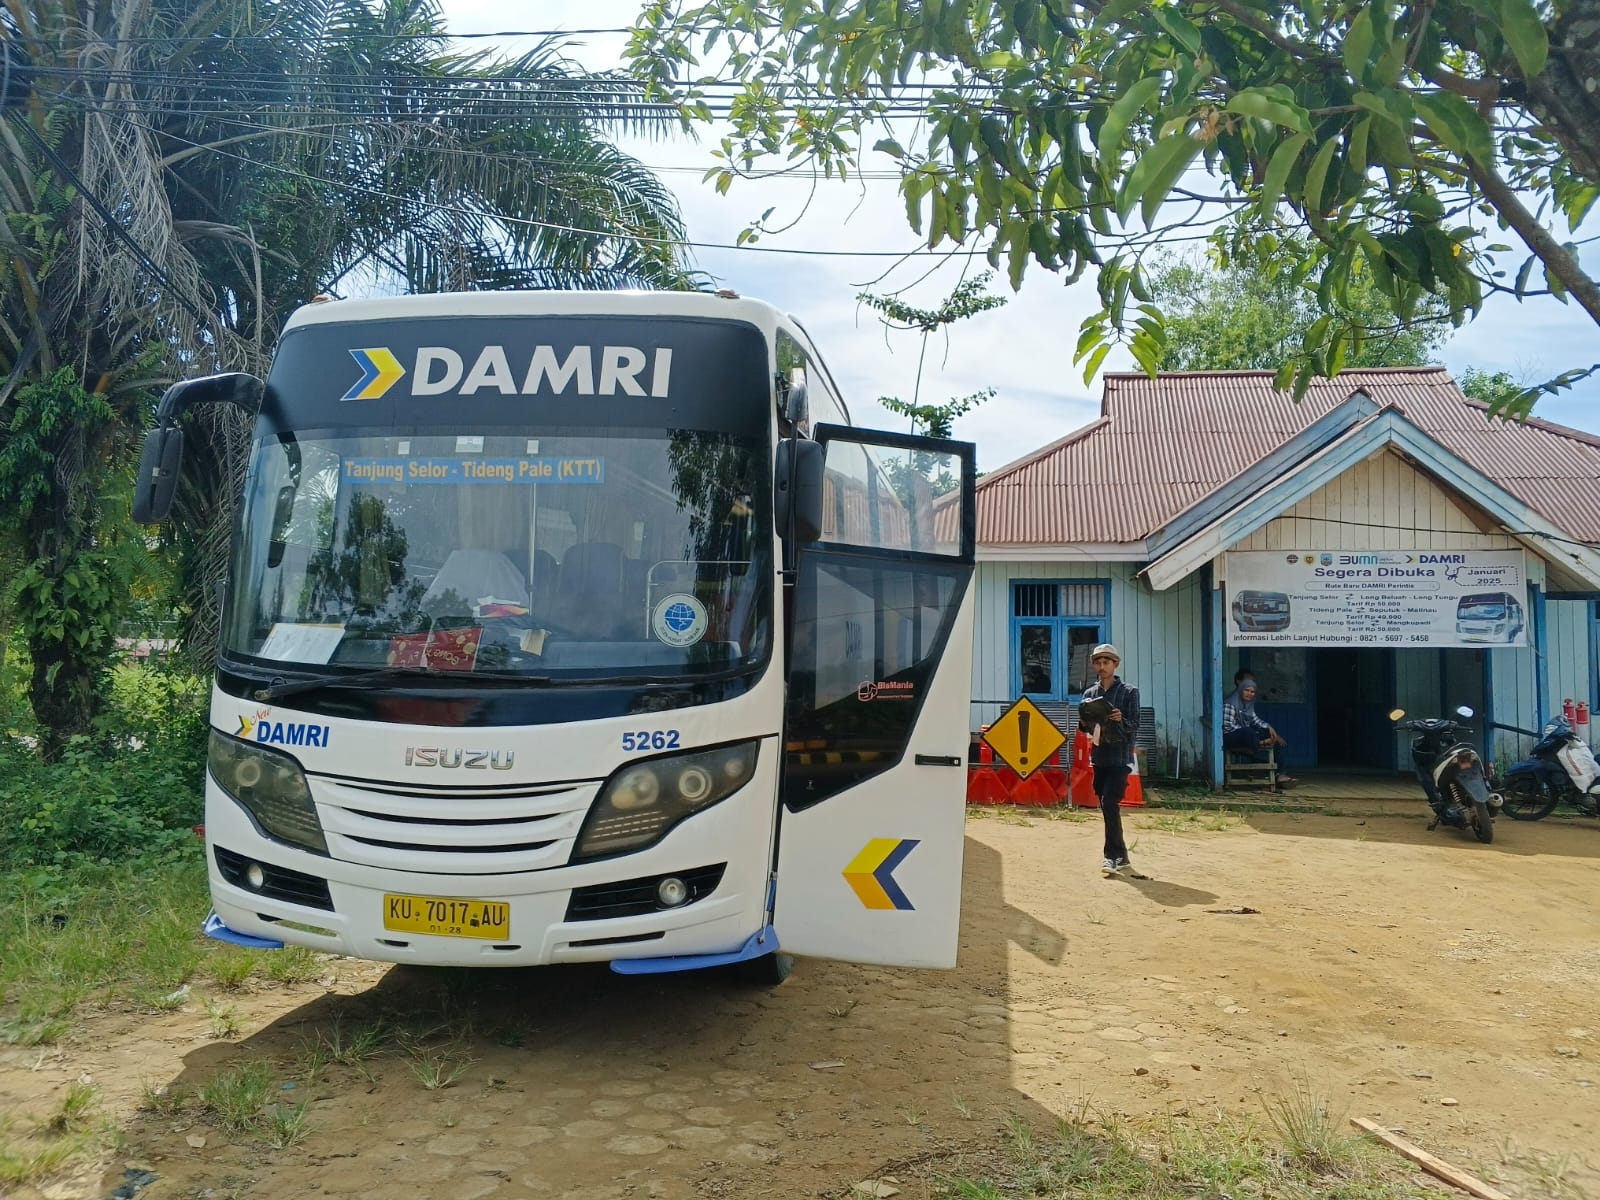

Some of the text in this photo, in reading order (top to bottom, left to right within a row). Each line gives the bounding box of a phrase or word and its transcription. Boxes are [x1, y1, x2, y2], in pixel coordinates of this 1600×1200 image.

[411, 345, 673, 398] DAMRI
[344, 461, 404, 481] Tanjung
[408, 461, 448, 478] Selor
[462, 460, 514, 481] Tideng
[519, 461, 552, 477] Pale
[558, 459, 601, 480] (KTT)
[1339, 555, 1378, 565] BUMN
[1419, 554, 1466, 564] DAMRI
[1315, 567, 1435, 578] Segera Dibuka
[1467, 568, 1506, 576] Januari
[1293, 634, 1318, 643] Lanjut
[1320, 634, 1353, 643] Hubungi
[1359, 634, 1378, 642] 0821
[1385, 634, 1403, 642] 5697
[1410, 634, 1430, 642] 5458
[250, 706, 272, 726] New
[257, 720, 330, 748] DAMRI
[622, 729, 681, 751] 5262
[404, 746, 515, 770] ISUZU
[390, 898, 503, 926] KU 7017 AU
